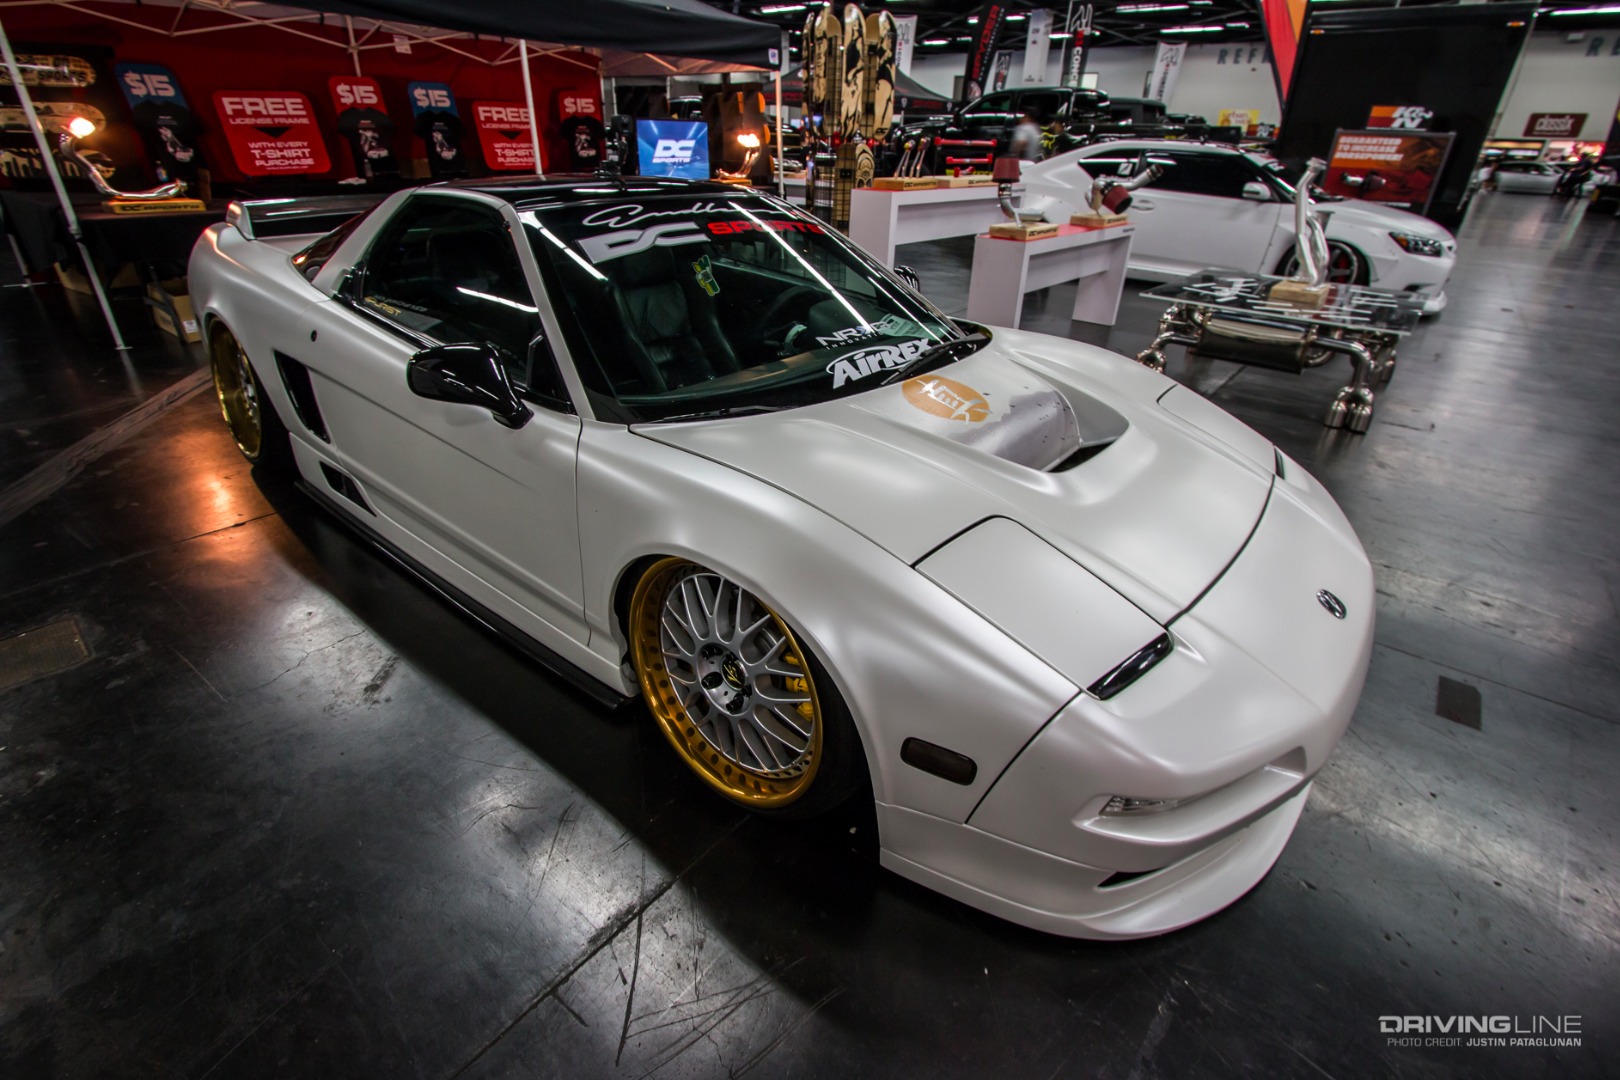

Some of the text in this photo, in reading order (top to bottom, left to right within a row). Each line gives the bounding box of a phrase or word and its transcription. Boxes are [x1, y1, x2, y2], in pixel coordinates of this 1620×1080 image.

[124, 70, 175, 97] $15
[336, 83, 378, 105] $15
[413, 87, 451, 108] $15
[221, 97, 307, 115] FREE
[478, 106, 530, 122] FREE
[563, 96, 595, 114] $15
[654, 139, 696, 157] DC
[1339, 136, 1402, 145] GUARANTEED
[1350, 145, 1398, 153] INCREASE
[251, 149, 311, 159] T-SHIRT
[255, 158, 315, 167] PURCHASE
[578, 220, 826, 264] DC SPORTS
